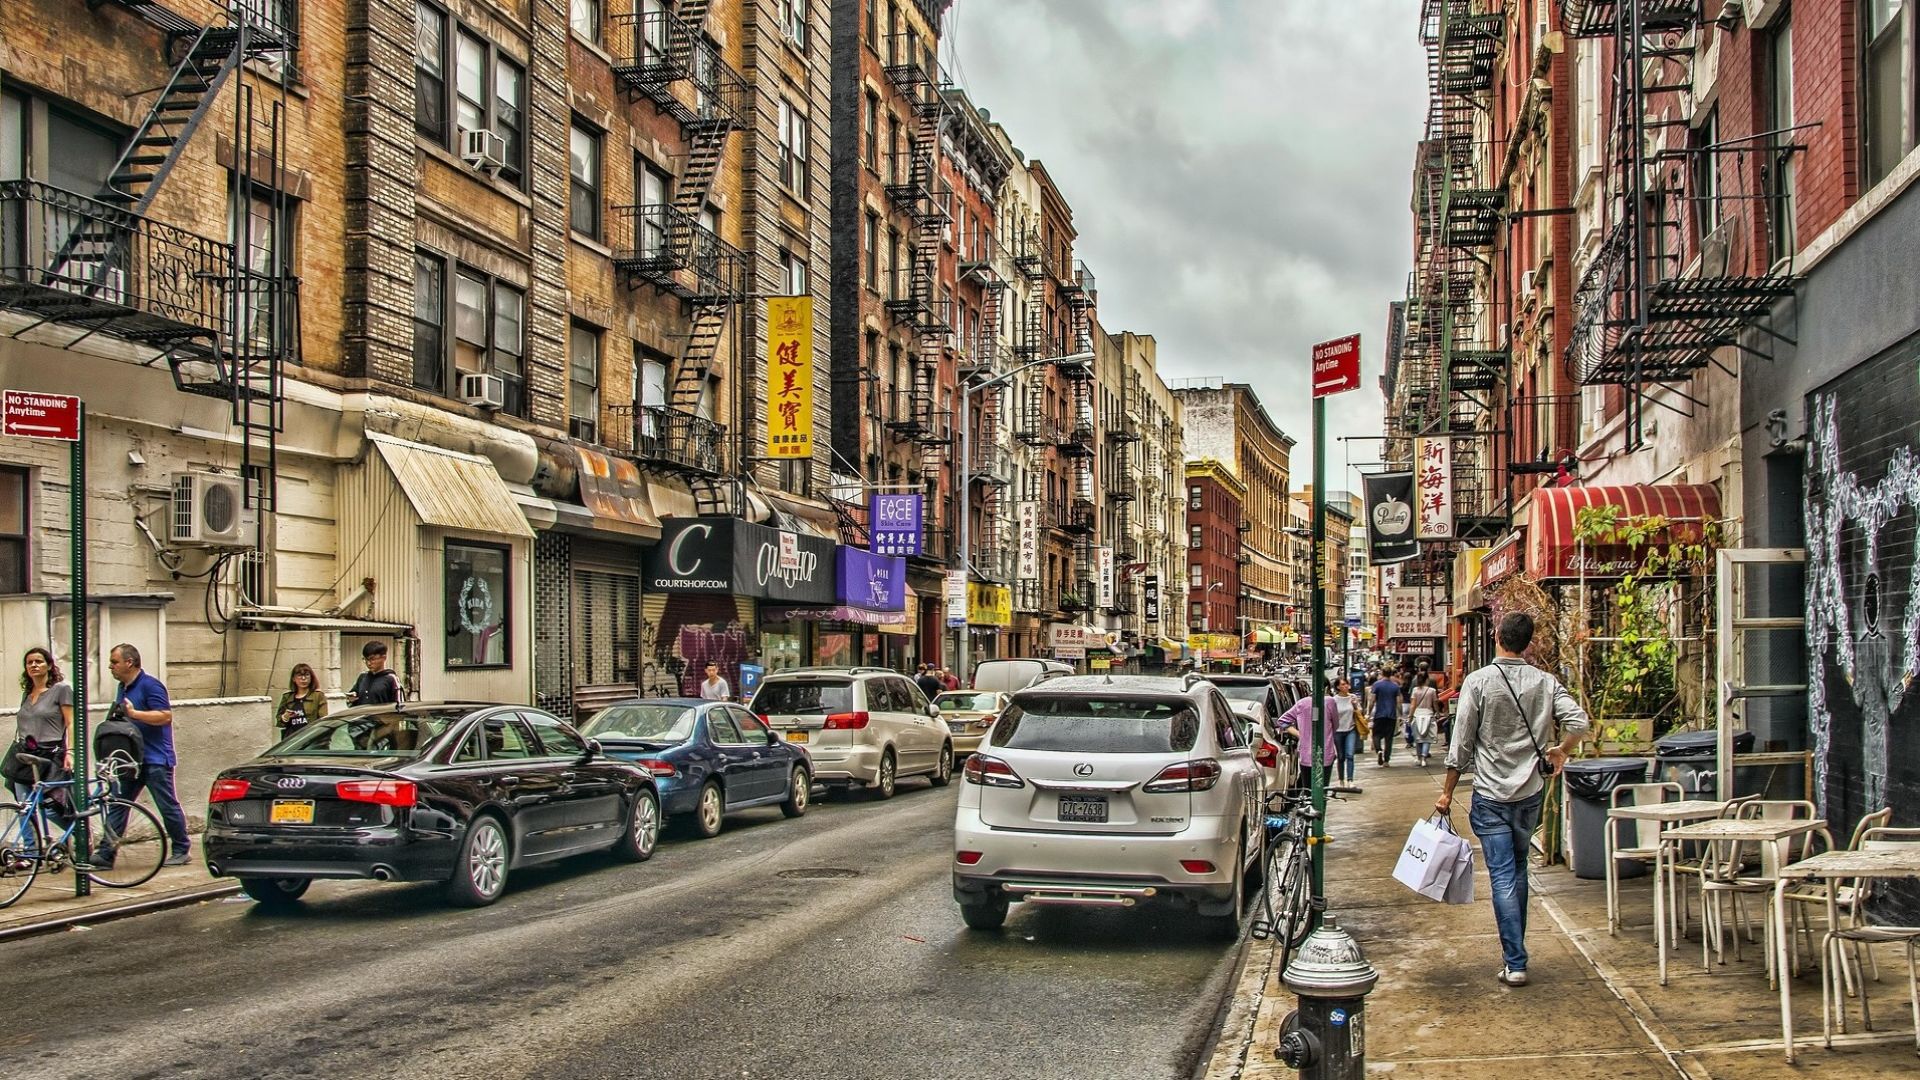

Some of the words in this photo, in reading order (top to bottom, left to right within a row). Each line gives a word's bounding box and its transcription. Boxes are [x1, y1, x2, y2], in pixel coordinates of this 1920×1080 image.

[1315, 349, 1324, 360] NO
[1324, 342, 1353, 358] STANDING
[1315, 358, 1339, 373] Anytime
[776, 340, 804, 431] 健美寶
[8, 396, 22, 405] NO
[24, 397, 68, 409] STANDING
[9, 406, 46, 418] Anytime
[1418, 440, 1448, 516] 新海洋
[669, 524, 713, 576] C
[654, 579, 728, 589] COURTSHOP.COM
[746, 673, 754, 685] P
[1354, 678, 1360, 687] P
[1405, 843, 1428, 863] ALDO
